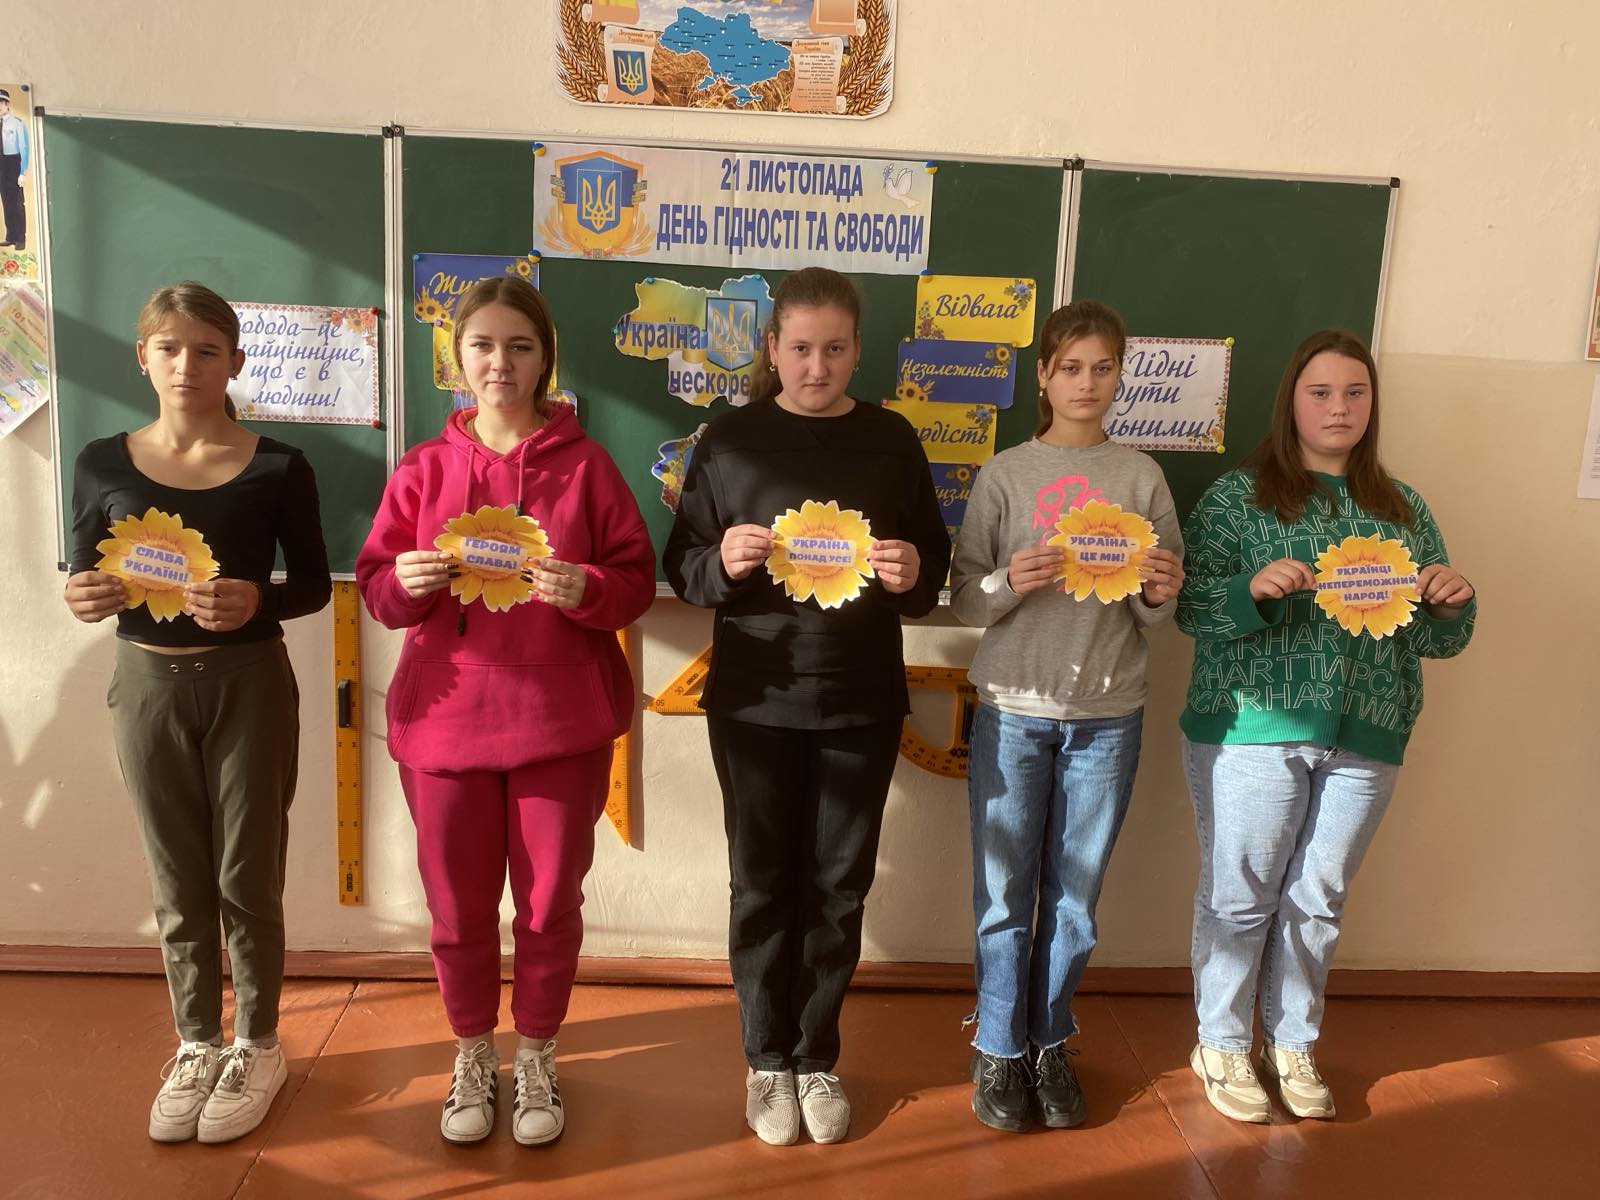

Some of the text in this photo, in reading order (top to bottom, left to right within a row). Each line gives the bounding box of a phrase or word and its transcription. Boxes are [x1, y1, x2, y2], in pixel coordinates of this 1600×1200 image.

[719, 157, 864, 203] 21 ЛИСТОПАДА
[656, 203, 925, 262] ДЕНЬ ГІДНОСТІ ТА СВОБОДИ
[935, 293, 1020, 319] Відвага
[618, 314, 701, 356] Україна
[242, 340, 365, 367] айцінніше,
[1128, 349, 1199, 379] Гідні
[250, 360, 330, 389] що є в
[900, 358, 1009, 381] Незалежність
[251, 384, 342, 408] людини!
[669, 369, 751, 403] нескоре
[915, 420, 988, 445] рдість
[1104, 418, 1215, 438] льними!
[465, 536, 521, 556] ГЕРОЯМ
[792, 537, 850, 550] УКРАЇНА
[1069, 535, 1128, 548] УКРАЇНА
[135, 546, 184, 566] СЛАВА
[466, 554, 518, 570] СЛАВА!
[789, 552, 852, 564] ПОНАД УСЕ!
[1079, 551, 1125, 563] ЦЕ МИ!
[124, 559, 189, 583] УКРАЇНІ!
[1336, 564, 1392, 576] УКРАЇНЦІ
[1343, 590, 1389, 602] НАРОД!
